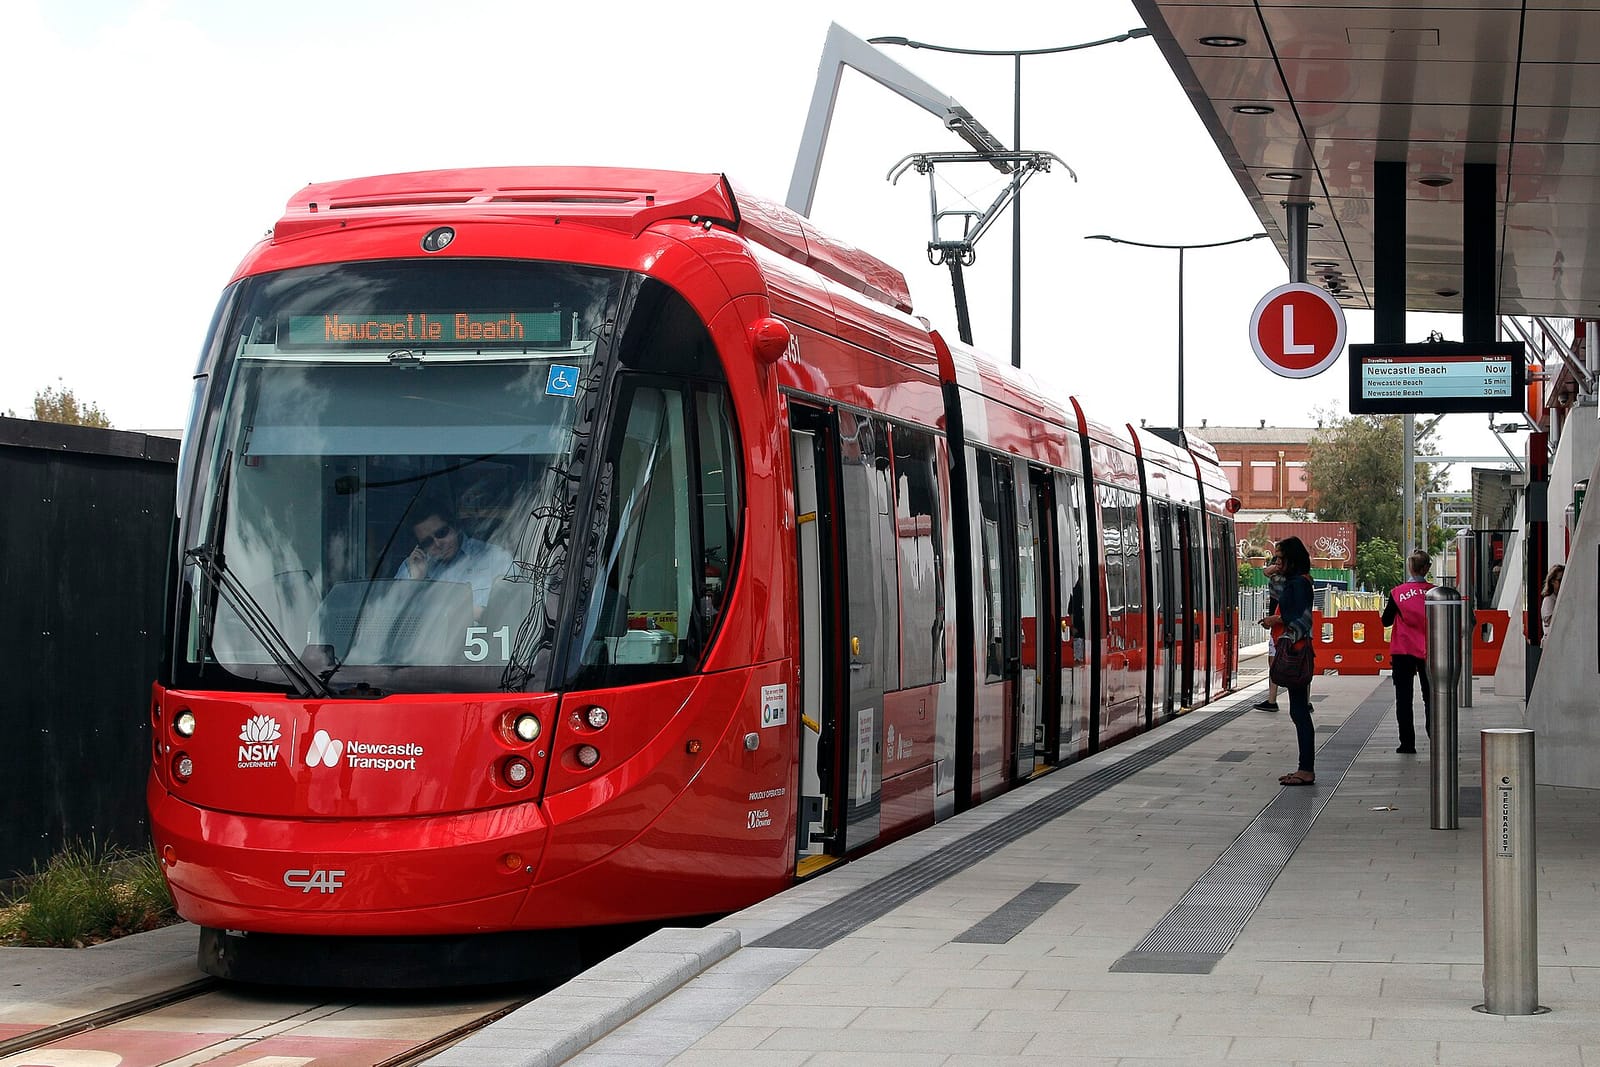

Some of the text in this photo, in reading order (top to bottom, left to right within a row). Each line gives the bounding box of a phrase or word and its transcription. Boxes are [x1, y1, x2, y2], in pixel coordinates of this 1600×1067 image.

[324, 313, 524, 341] Newcastle Beach
[1283, 304, 1315, 355] L
[1367, 366, 1447, 375] Newcastle Beach
[1485, 365, 1507, 374] Now
[1399, 588, 1418, 602] Ask
[464, 626, 511, 662] 51
[238, 745, 280, 763] NSW
[347, 740, 423, 756] Newcastle
[347, 755, 416, 771] Transport
[283, 869, 346, 894] CAF
